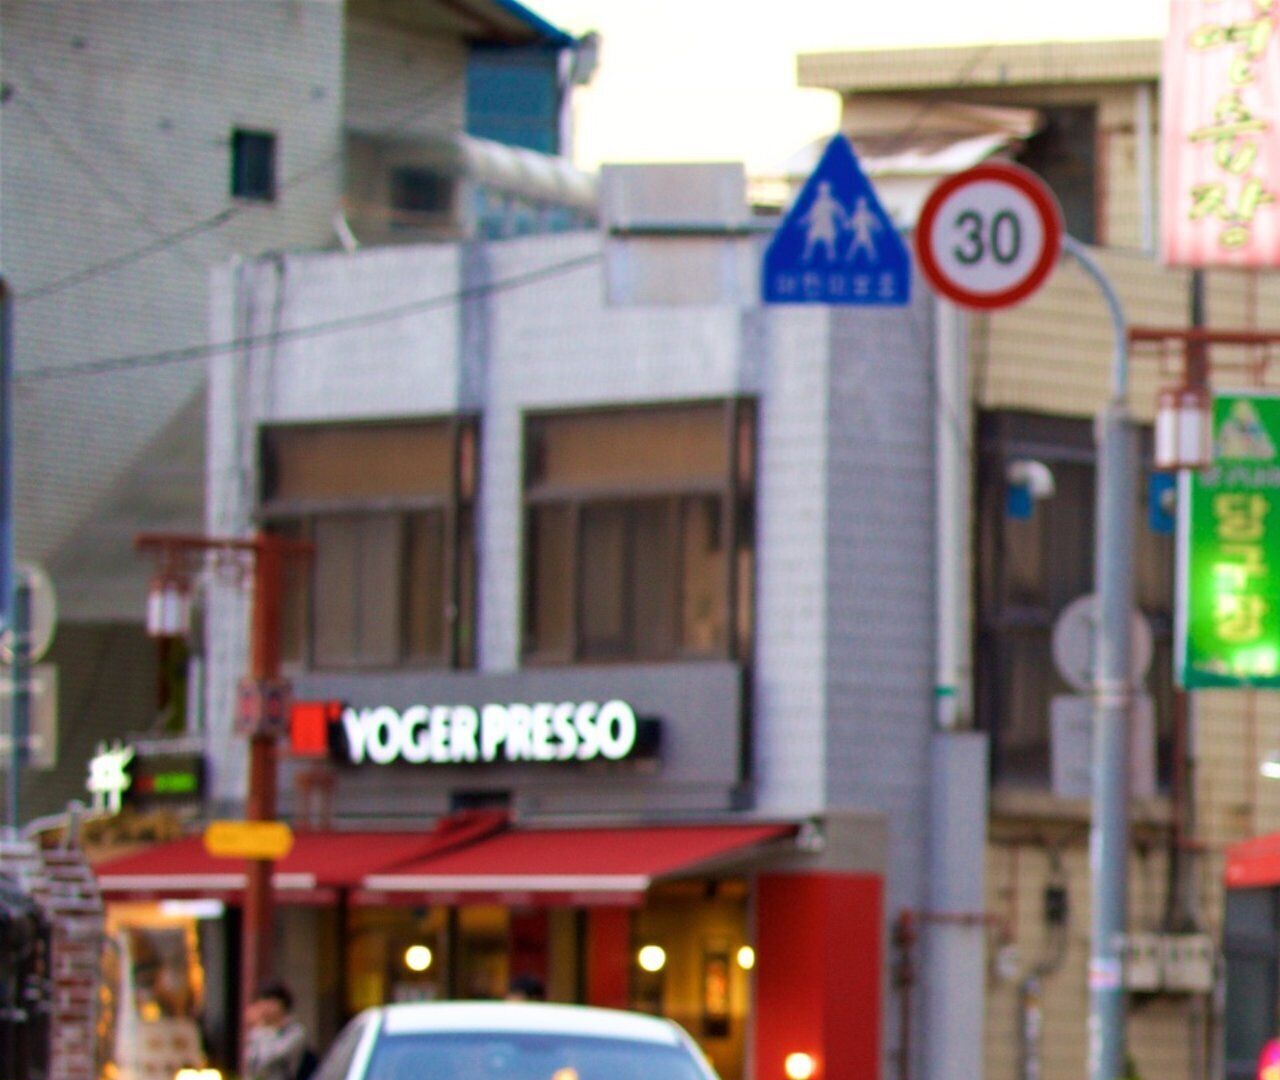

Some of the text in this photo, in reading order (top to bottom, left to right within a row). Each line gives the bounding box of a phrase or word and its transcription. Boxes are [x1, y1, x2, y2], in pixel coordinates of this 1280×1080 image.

[953, 208, 1022, 266] 30
[341, 699, 637, 765] YOGER PRESSO
